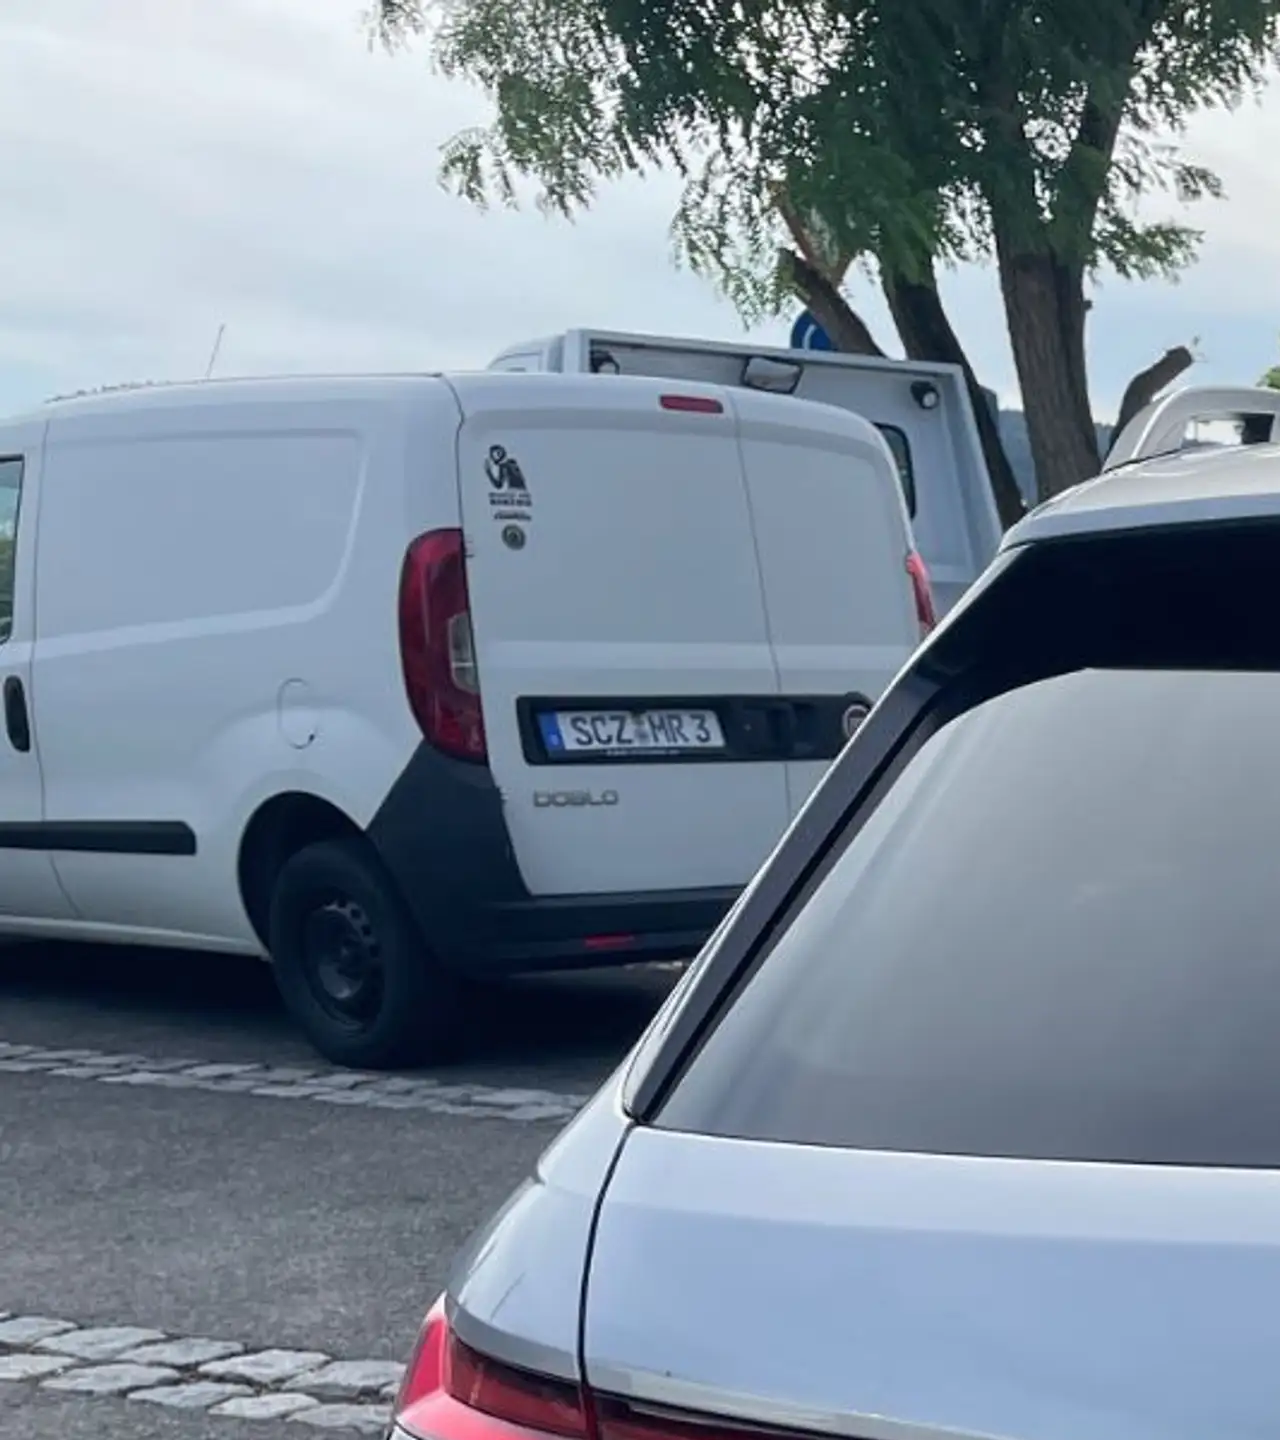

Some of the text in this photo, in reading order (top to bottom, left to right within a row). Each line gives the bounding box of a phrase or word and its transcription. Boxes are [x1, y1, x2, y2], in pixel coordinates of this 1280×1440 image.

[570, 713, 711, 746] SCZ MR 3
